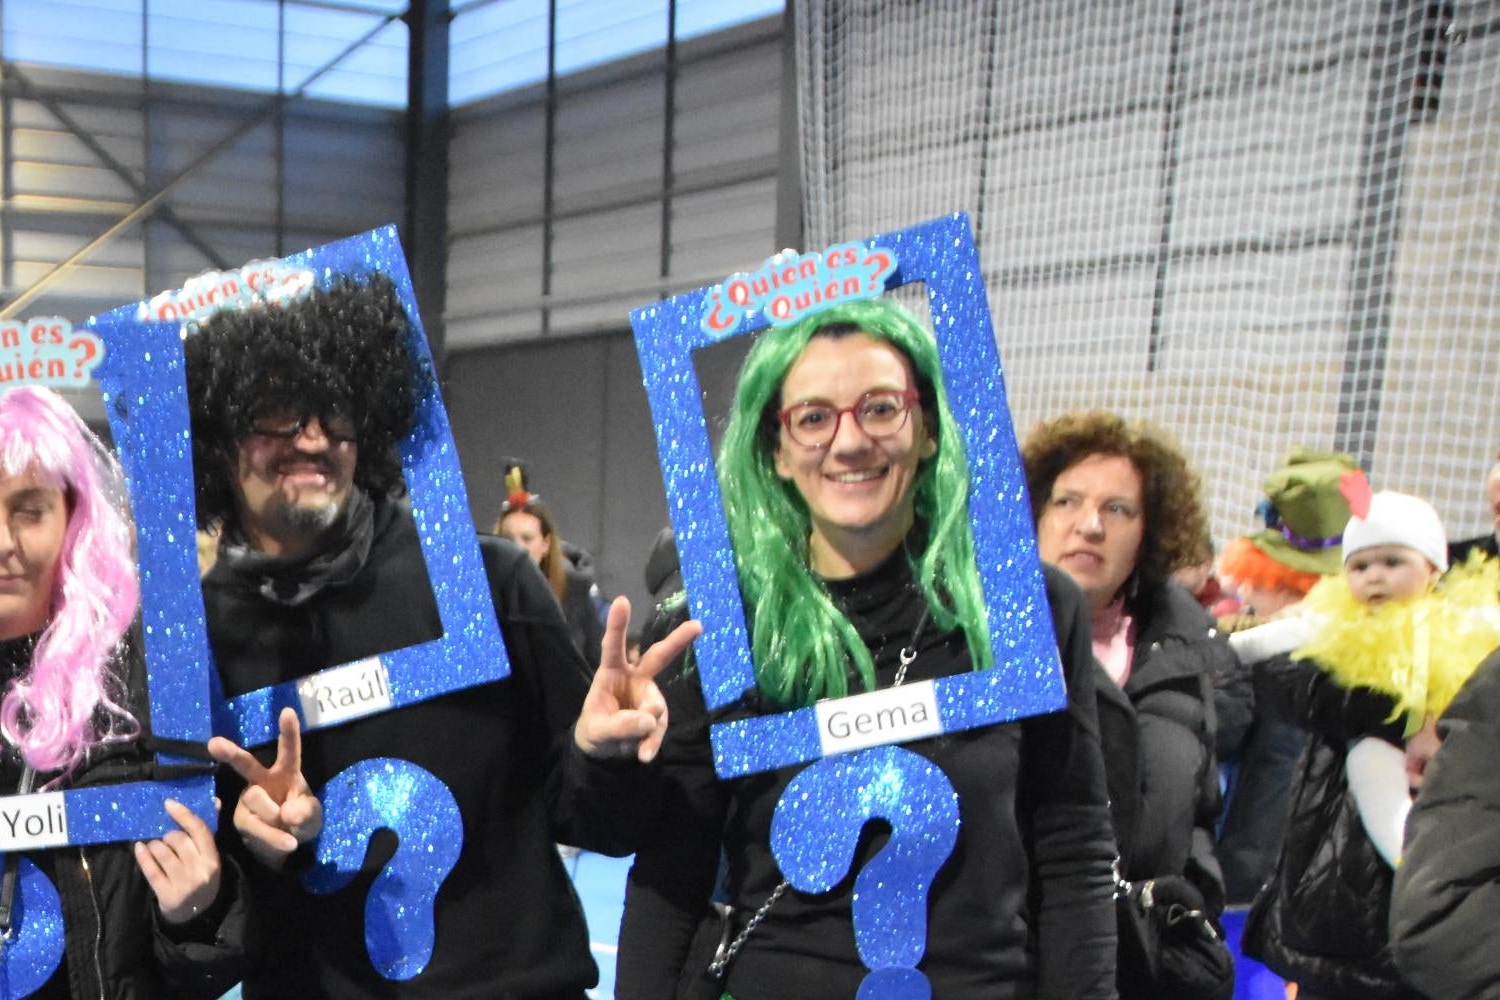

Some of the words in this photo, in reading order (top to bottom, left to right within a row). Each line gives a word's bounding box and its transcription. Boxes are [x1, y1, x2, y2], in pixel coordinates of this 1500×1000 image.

[707, 257, 816, 330] ¿Quién
[826, 247, 858, 269] es
[771, 252, 890, 320] Quién?
[30, 324, 64, 346] es
[314, 669, 385, 713] Raúl
[827, 701, 928, 740] Gema
[2, 804, 64, 839] Yoli
